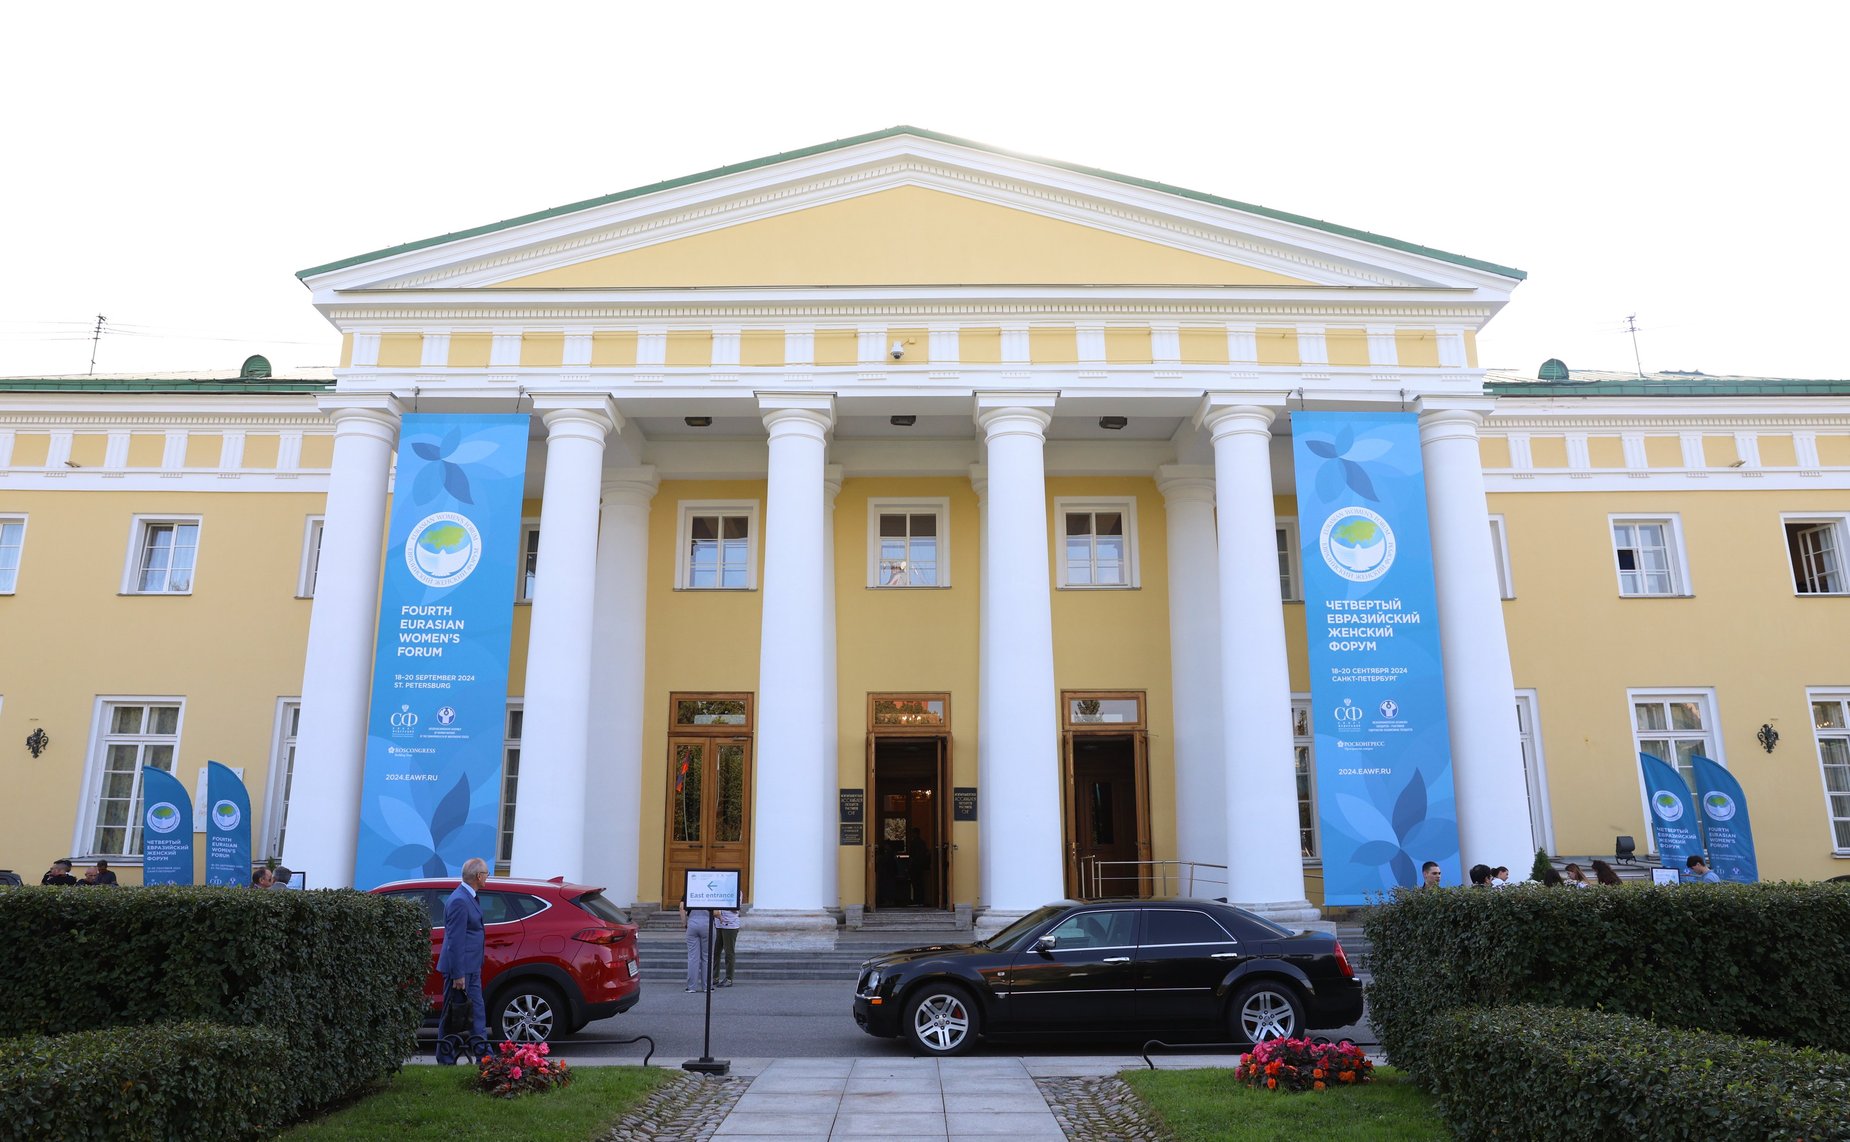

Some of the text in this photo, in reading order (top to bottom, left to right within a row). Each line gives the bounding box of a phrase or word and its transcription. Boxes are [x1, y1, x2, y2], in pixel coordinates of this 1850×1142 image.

[1326, 598, 1402, 610] ЧЕТВЕРТЫЙ
[401, 606, 453, 616] FOURTH
[1327, 611, 1421, 624] ЕВРАЗИЙСКИЙ
[400, 619, 465, 630] EURASIAN
[1328, 625, 1394, 638] ЖЕНСКИЙ
[399, 633, 460, 643] WOMEN'S
[397, 646, 443, 657] FORUM
[1329, 641, 1377, 651] ФОРУМ
